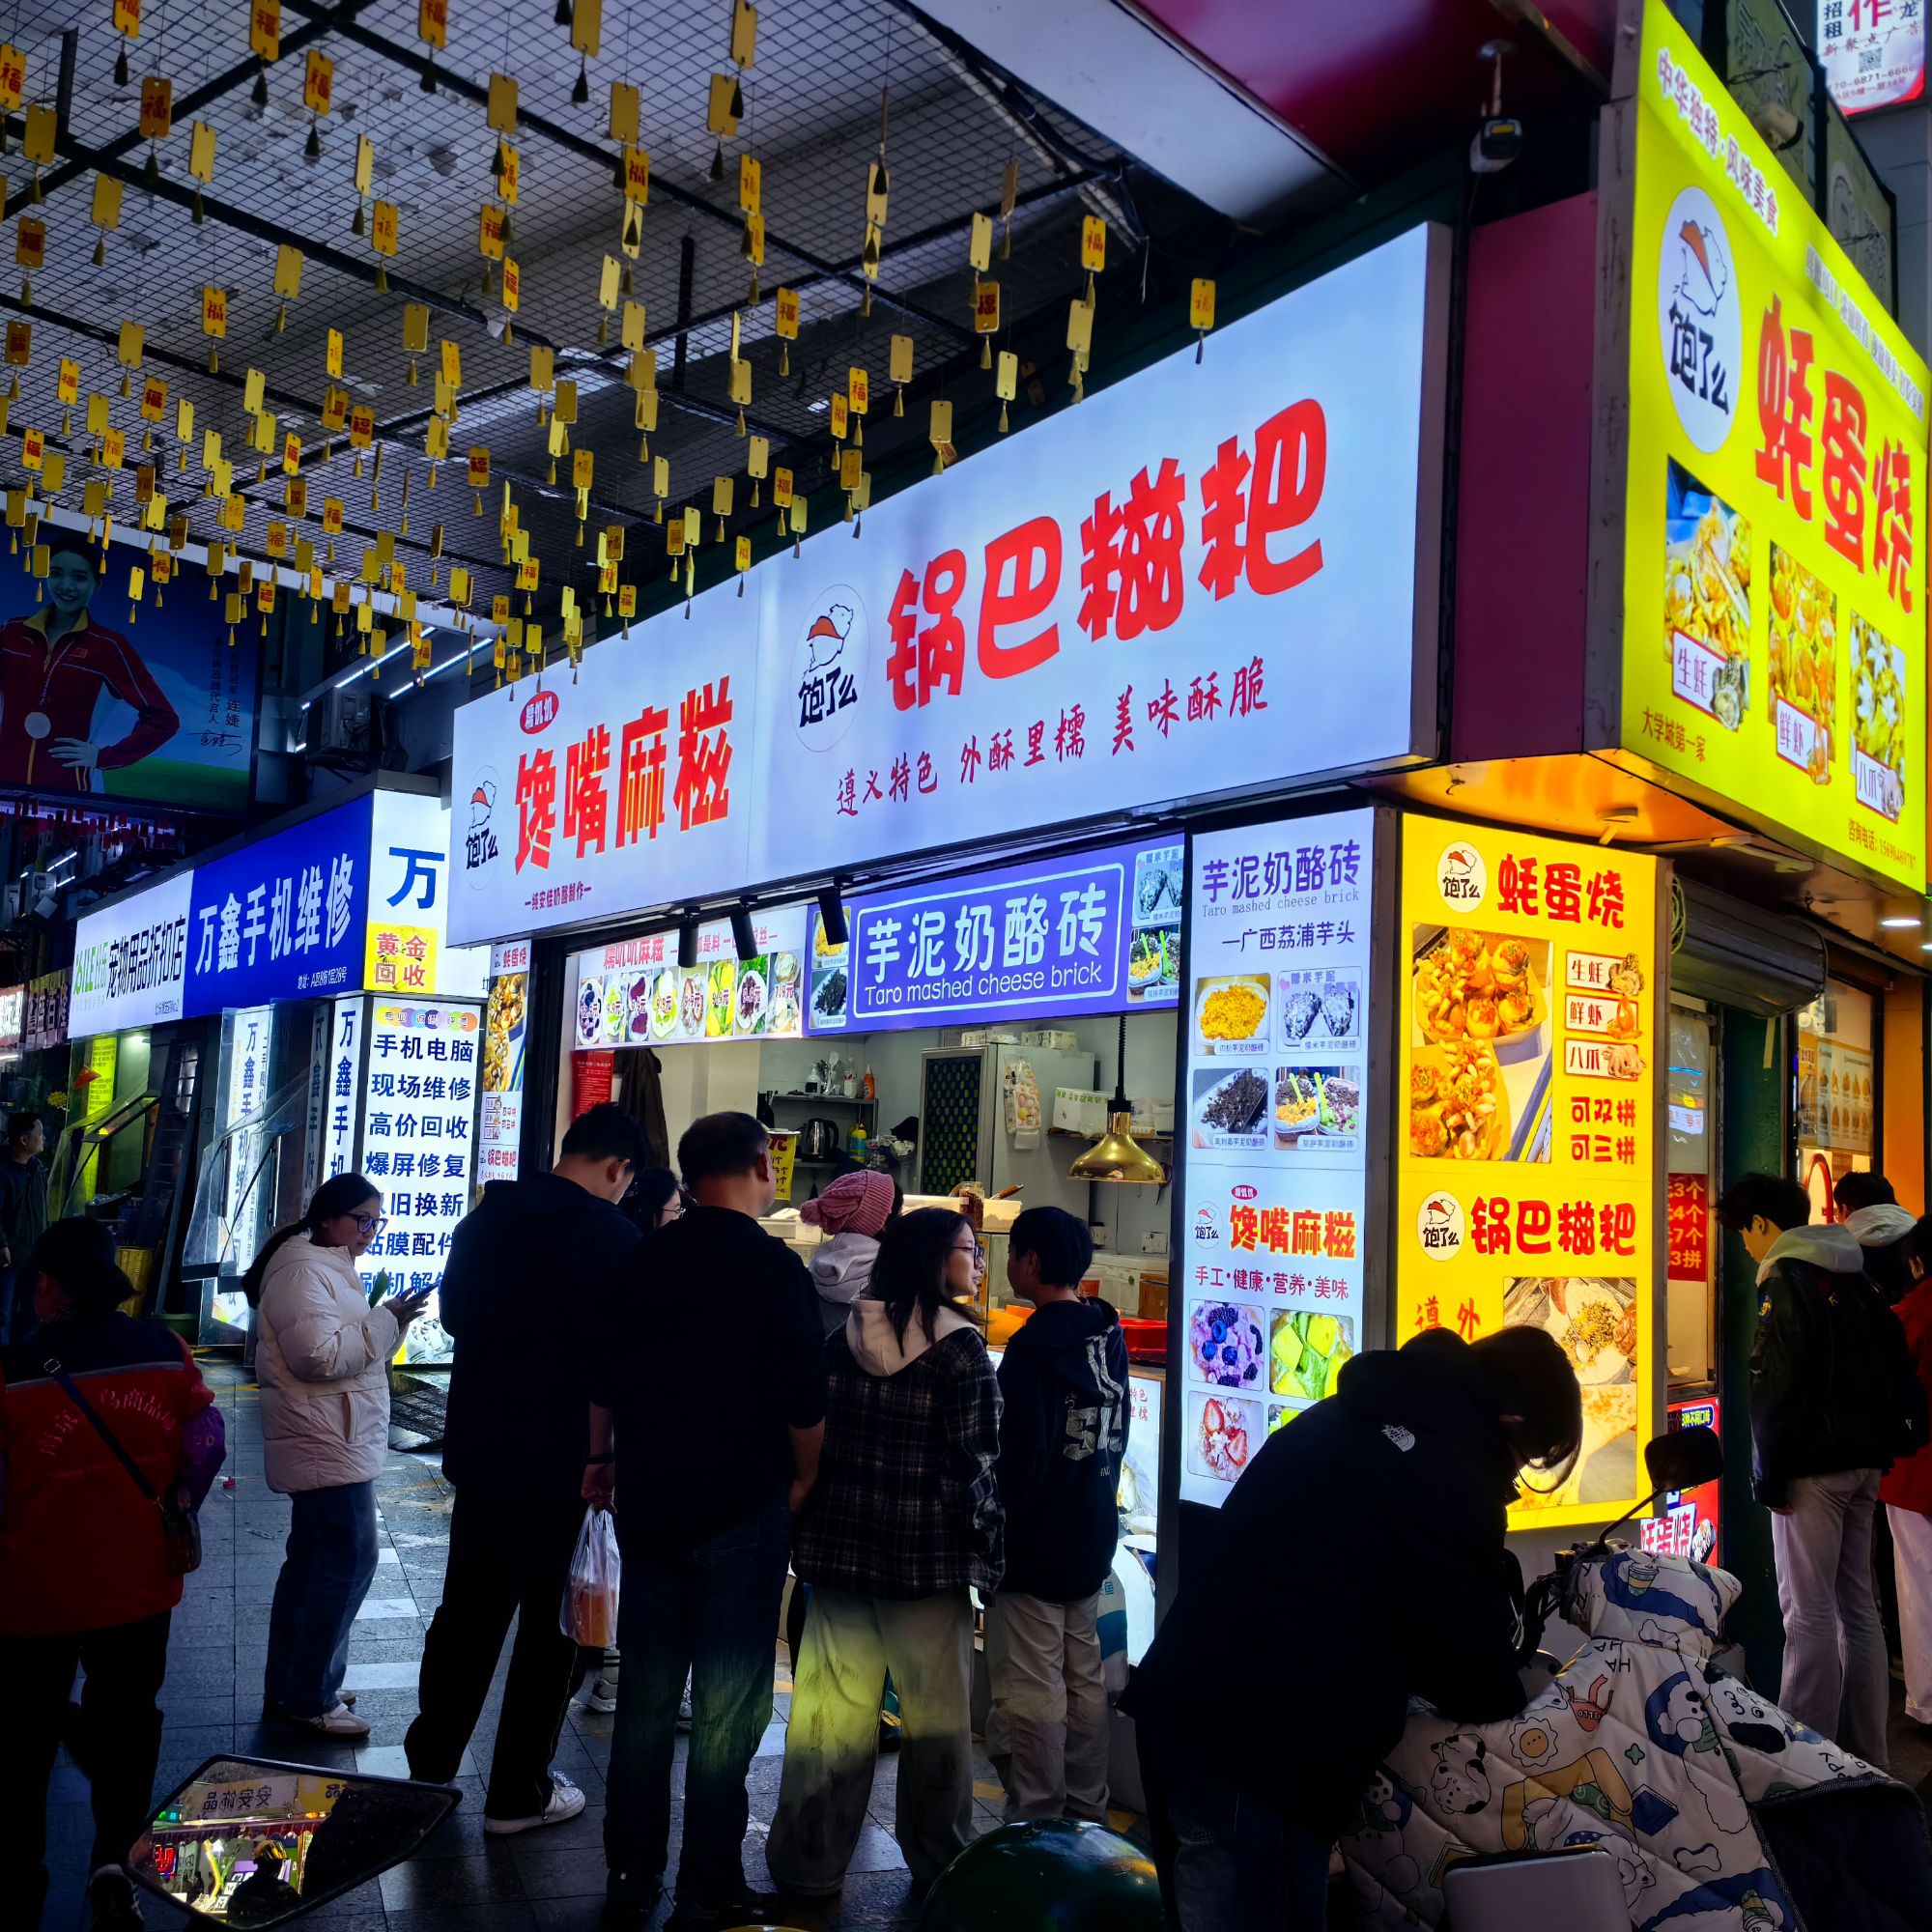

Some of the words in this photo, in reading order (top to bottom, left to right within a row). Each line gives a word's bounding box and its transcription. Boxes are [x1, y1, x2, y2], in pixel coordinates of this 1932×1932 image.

[256, 9, 278, 38] 福
[0, 62, 22, 95] 福
[308, 68, 329, 100] 福
[1088, 235, 1103, 251] 福
[207, 299, 223, 322] 福
[780, 302, 796, 322] 福
[1668, 298, 1729, 415] 饱了么
[145, 388, 163, 409] 福
[353, 416, 371, 436] 福
[26, 440, 41, 458] 福
[1755, 292, 1913, 614] 蚝蛋烧
[470, 456, 487, 473] 福
[270, 532, 283, 547] 福
[153, 560, 170, 574] 福
[886, 398, 1326, 711] 锅巴糍粑
[1677, 646, 1708, 700] 生蚝
[798, 667, 858, 728] 饱了么
[837, 750, 937, 815] 遵义特色
[960, 704, 1085, 783] 外酥里糯
[1112, 656, 1267, 755] 美味酥脆
[1642, 705, 1706, 762] 大学城第一家
[1778, 710, 1804, 757] 鲜虾
[514, 675, 733, 875] 馋嘴麻糍
[466, 830, 498, 870] 饱了么
[386, 847, 445, 909] 万
[1202, 838, 1361, 903] 芋泥奶酪砖
[1442, 876, 1481, 899] 饱了么
[1498, 854, 1625, 928] 蚝蛋烧
[195, 852, 355, 977] 万鑫手机维修
[1202, 904, 1227, 918] Taro
[1232, 899, 1270, 915] mashed
[1278, 895, 1318, 910] cheese
[1324, 890, 1359, 905] brick
[376, 932, 428, 959] 黄金
[866, 883, 1107, 983] 芋泥奶酪砖
[106, 914, 185, 999] 宠物用品折扣店
[374, 962, 426, 989] 回收
[865, 985, 902, 1008] Taro
[907, 975, 972, 1004] mashed
[979, 969, 1043, 995] cheese
[1051, 961, 1102, 988] brick
[1572, 959, 1605, 984] 生蚝
[1569, 1002, 1604, 1026] 鲜虾
[373, 1034, 474, 1063] 手机电脑
[371, 1073, 471, 1101] 现场维修
[368, 1112, 469, 1140] 高价回收
[1571, 1096, 1635, 1127] 可双拼
[1571, 1134, 1635, 1165] 可三拼
[365, 1151, 466, 1179] 爆屏修复
[1668, 1180, 1704, 1199] 3个
[1471, 1196, 1636, 1256] 锅巴糍粑
[1668, 1205, 1704, 1223] 4个
[1195, 1226, 1219, 1240] 饱了么
[1230, 1204, 1356, 1259] 馋嘴麻糍
[1423, 1227, 1460, 1249] 饱了么
[1668, 1229, 1704, 1246] 7个
[1668, 1250, 1702, 1269] 3拼
